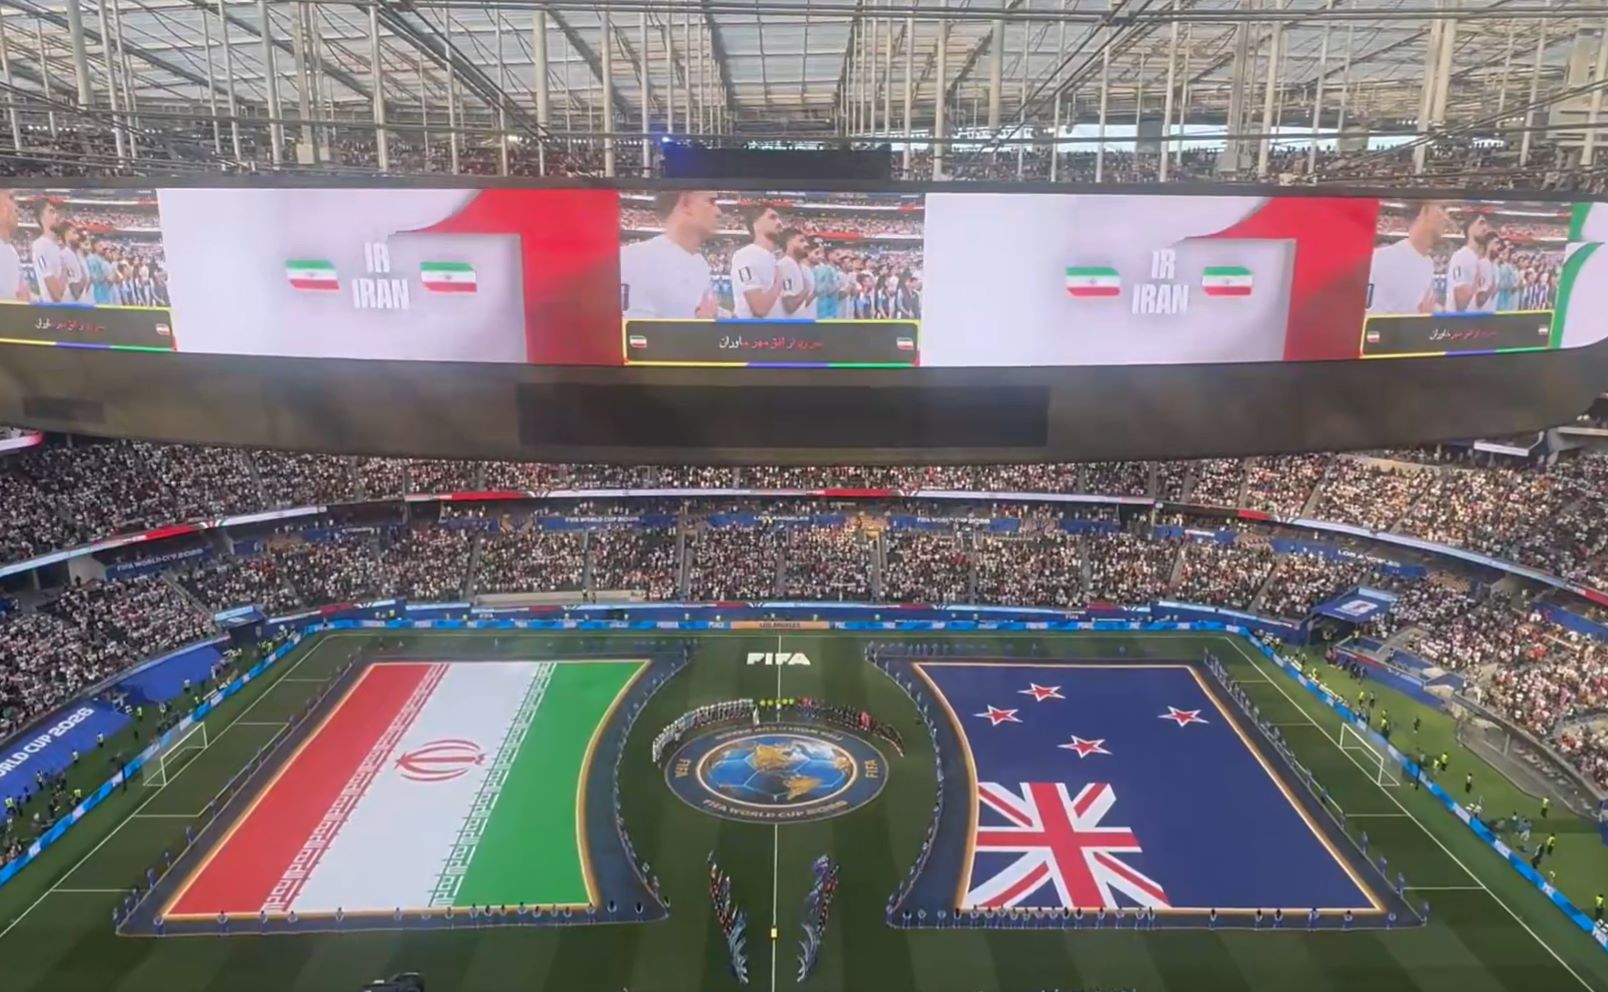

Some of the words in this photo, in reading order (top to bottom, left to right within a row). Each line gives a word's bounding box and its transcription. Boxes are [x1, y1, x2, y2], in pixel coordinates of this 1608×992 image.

[364, 241, 390, 273] IR
[1151, 248, 1176, 279] IR
[351, 277, 409, 309] IRAN
[1132, 283, 1189, 315] IRAN
[747, 652, 811, 666] FIFA
[24, 734, 52, 754] CUP
[48, 707, 95, 737] 2026
